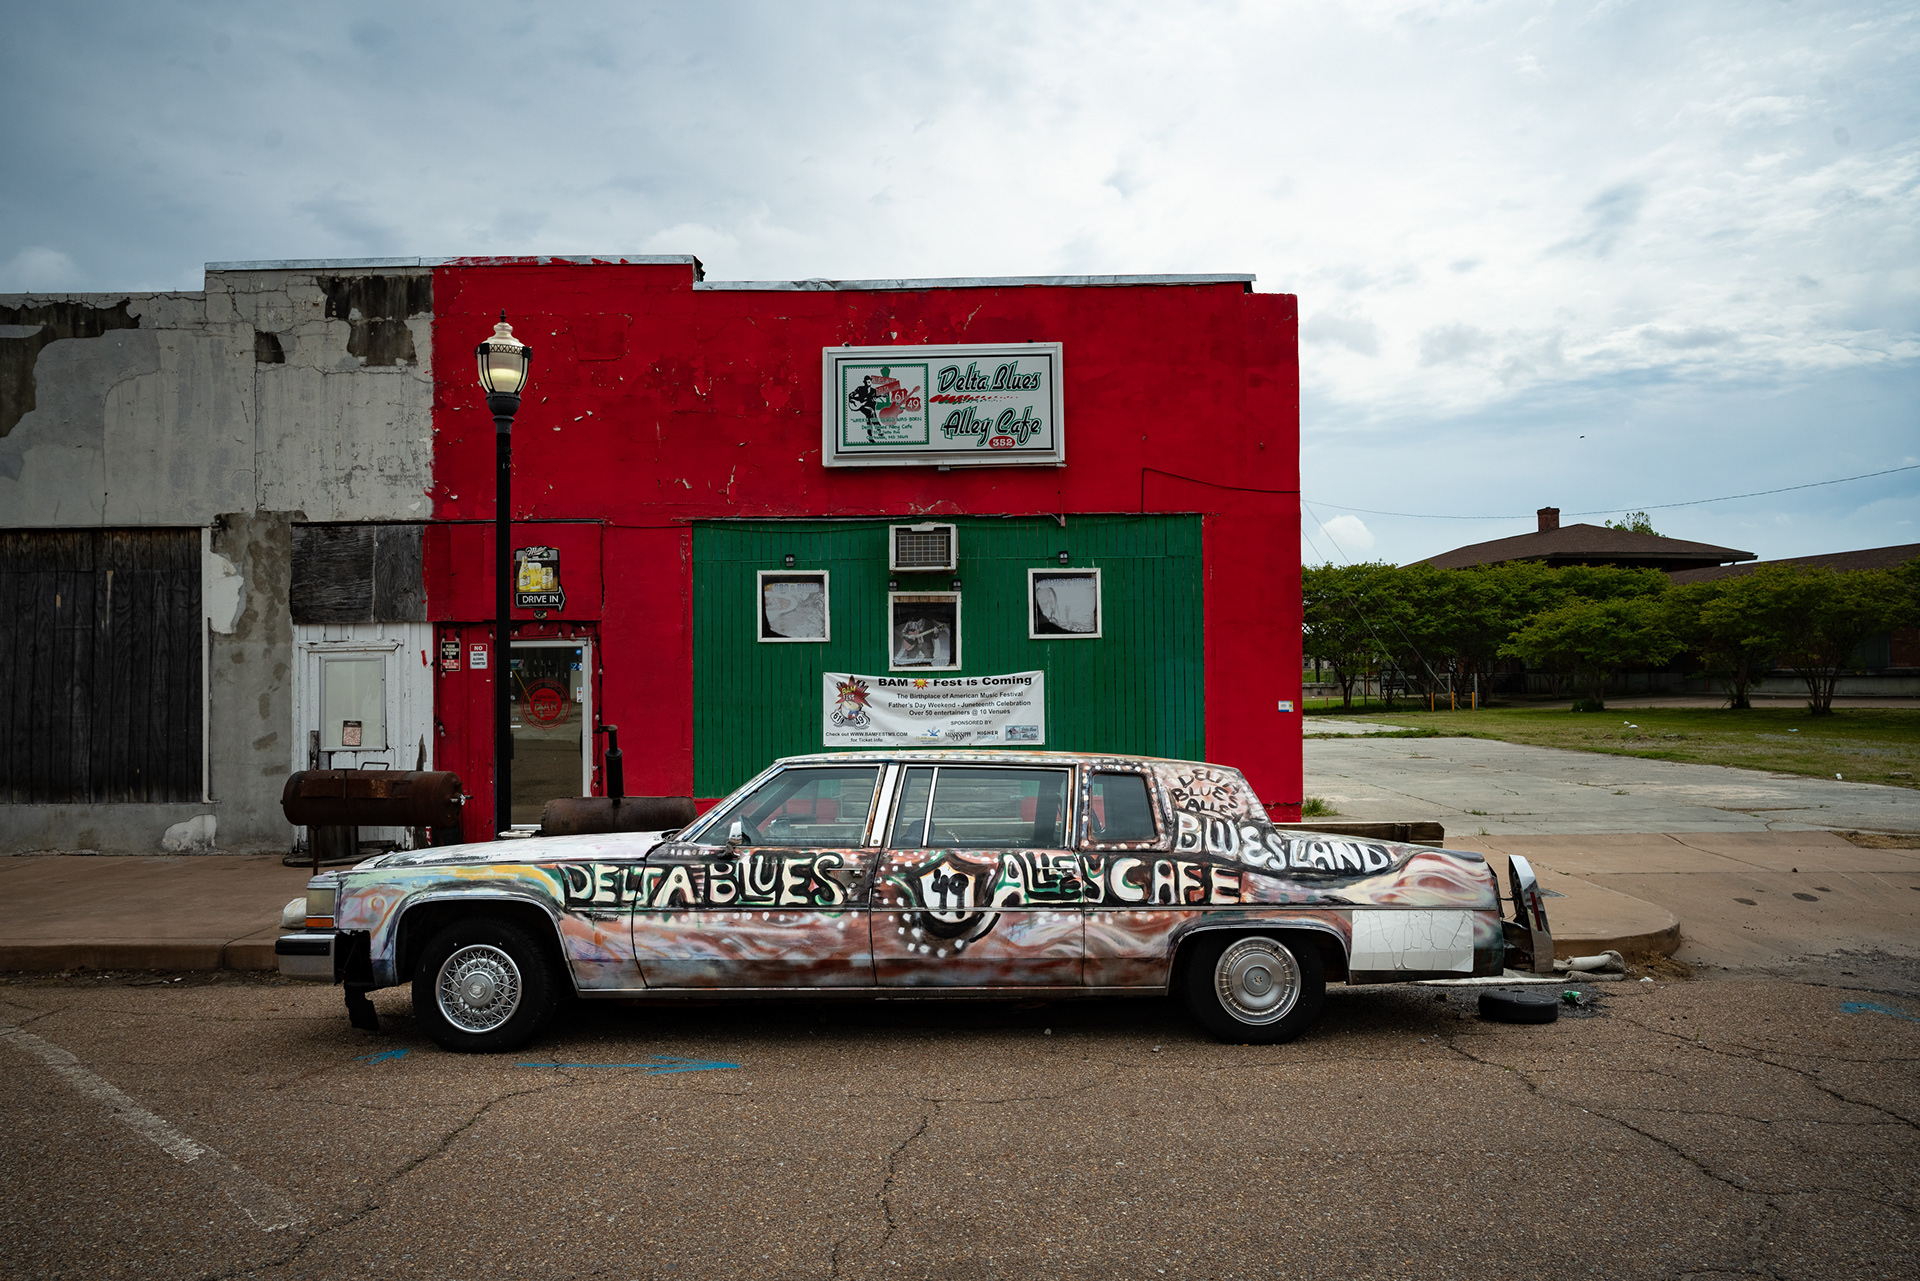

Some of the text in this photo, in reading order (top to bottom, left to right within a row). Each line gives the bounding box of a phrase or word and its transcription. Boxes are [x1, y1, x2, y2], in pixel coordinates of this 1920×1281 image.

[938, 361, 1041, 393] Delta Blues
[895, 390, 905, 401] 61
[907, 399, 919, 409] 49
[941, 406, 1041, 446] Alley Cafe
[992, 439, 1013, 447] 352
[522, 595, 559, 603] DRIVE IN
[878, 679, 908, 687] BAM
[933, 679, 963, 687] Fest
[982, 676, 1032, 686] Coming
[841, 685, 857, 696] BAM
[533, 699, 558, 711] BAR
[833, 712, 842, 722] 61
[856, 715, 865, 725] 49
[1178, 769, 1240, 795] DELTA
[1171, 786, 1238, 809] BLUES
[1186, 798, 1243, 824] ALLEY
[568, 853, 845, 906] DELTA BLUES
[1109, 857, 1240, 904] CAFE
